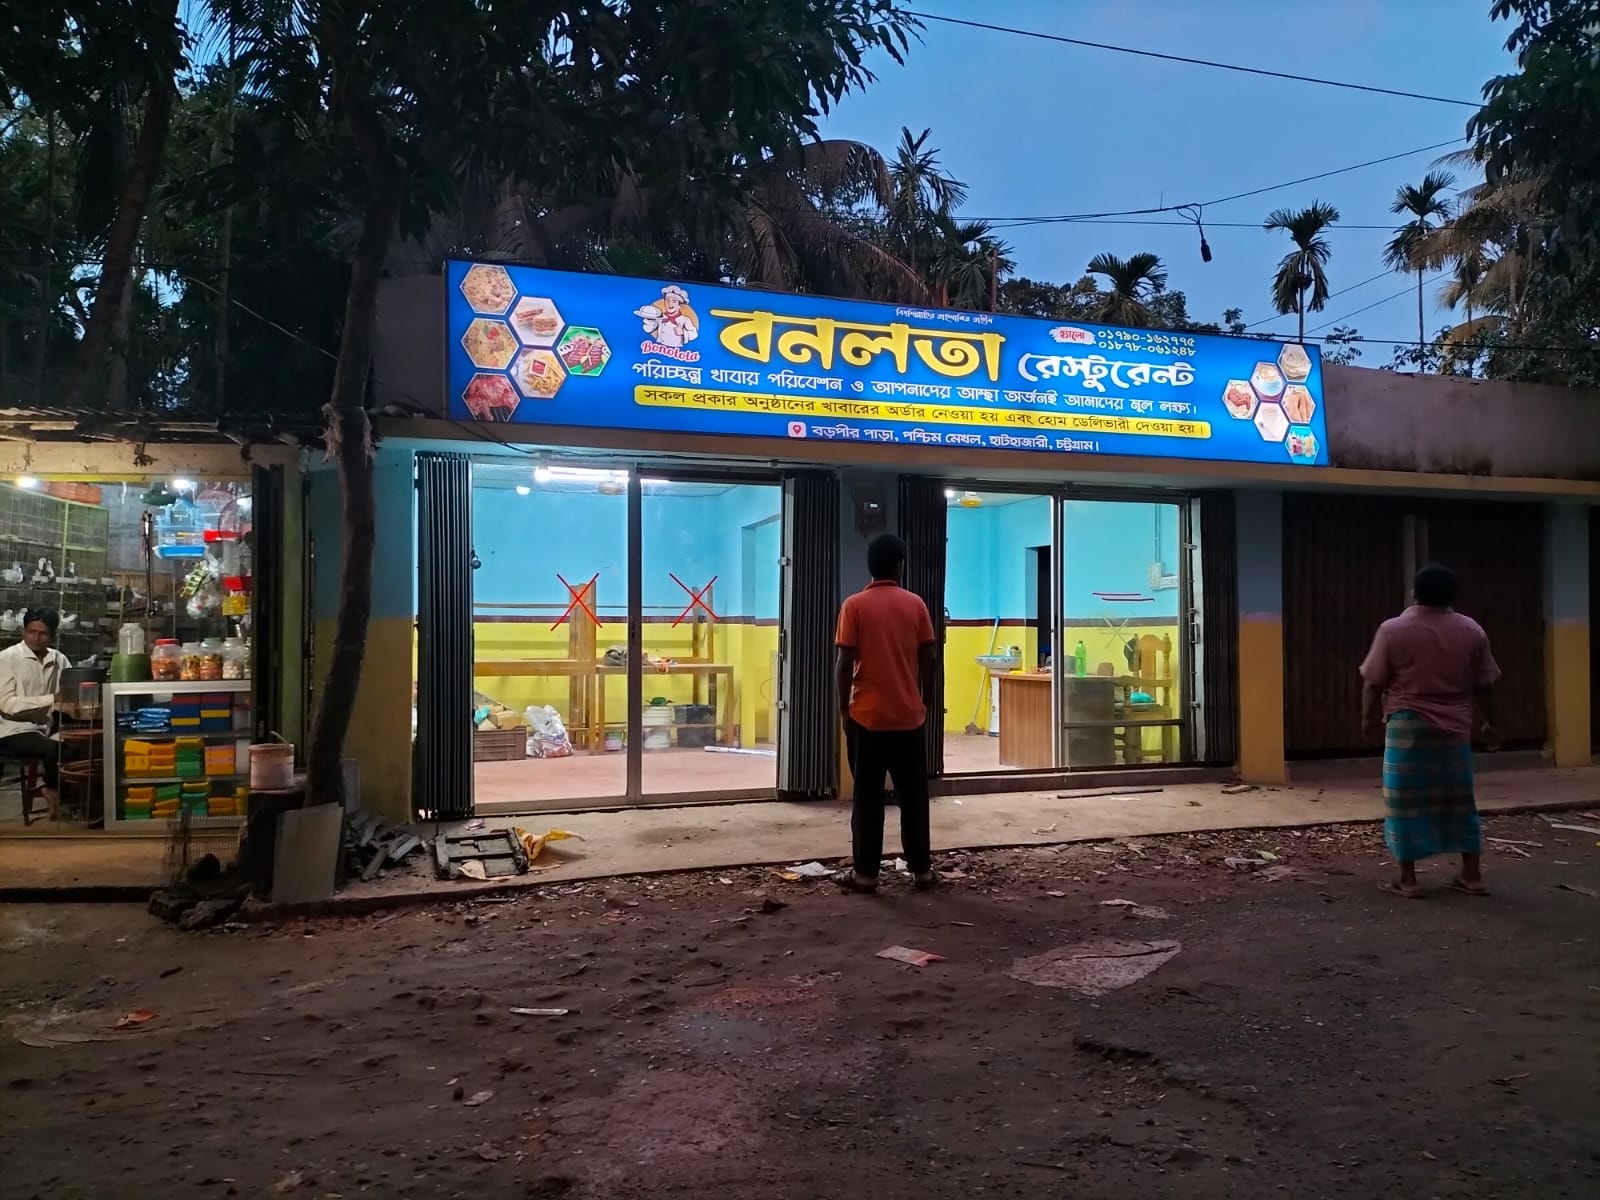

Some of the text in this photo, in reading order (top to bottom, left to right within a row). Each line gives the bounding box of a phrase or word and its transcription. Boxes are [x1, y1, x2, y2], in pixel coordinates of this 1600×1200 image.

[641, 340, 701, 362] Bonolota
[710, 309, 1006, 382] বনলতা
[1059, 330, 1085, 341] হ্যালো
[1098, 340, 1197, 357] ০১৮৭৮-০৬১২৪৮
[632, 359, 703, 385] পরিচ্ছন্ন
[710, 368, 760, 386] খাবার
[767, 369, 843, 392] পরিবেশন
[851, 380, 865, 393] ও
[870, 380, 952, 399] আপনাদের
[956, 386, 999, 403] আস্থা
[1003, 388, 1058, 406] অর্জনই
[1062, 394, 1125, 411] আমাদের
[1018, 352, 1196, 393] রেস্টুরেন্ট
[643, 388, 687, 403] সকল
[692, 392, 737, 407] প্রকার
[743, 394, 815, 412] অনুষ্ঠানের
[821, 400, 880, 416] খাবারের
[885, 403, 926, 419] অর্ডার
[931, 408, 974, 422] নেওয়া
[979, 411, 999, 423] হয়
[1005, 412, 1033, 425] এবং
[1038, 415, 1067, 427] হোম
[1072, 416, 1130, 430] ডেলিভারী
[1136, 420, 1173, 433] দেওয়া
[811, 423, 860, 440] বড়পীর
[863, 427, 899, 442] পাড়া,
[902, 427, 942, 444] পশ্চিম
[945, 433, 986, 447] মেখল,
[988, 433, 1053, 450] হাটহাজারী,
